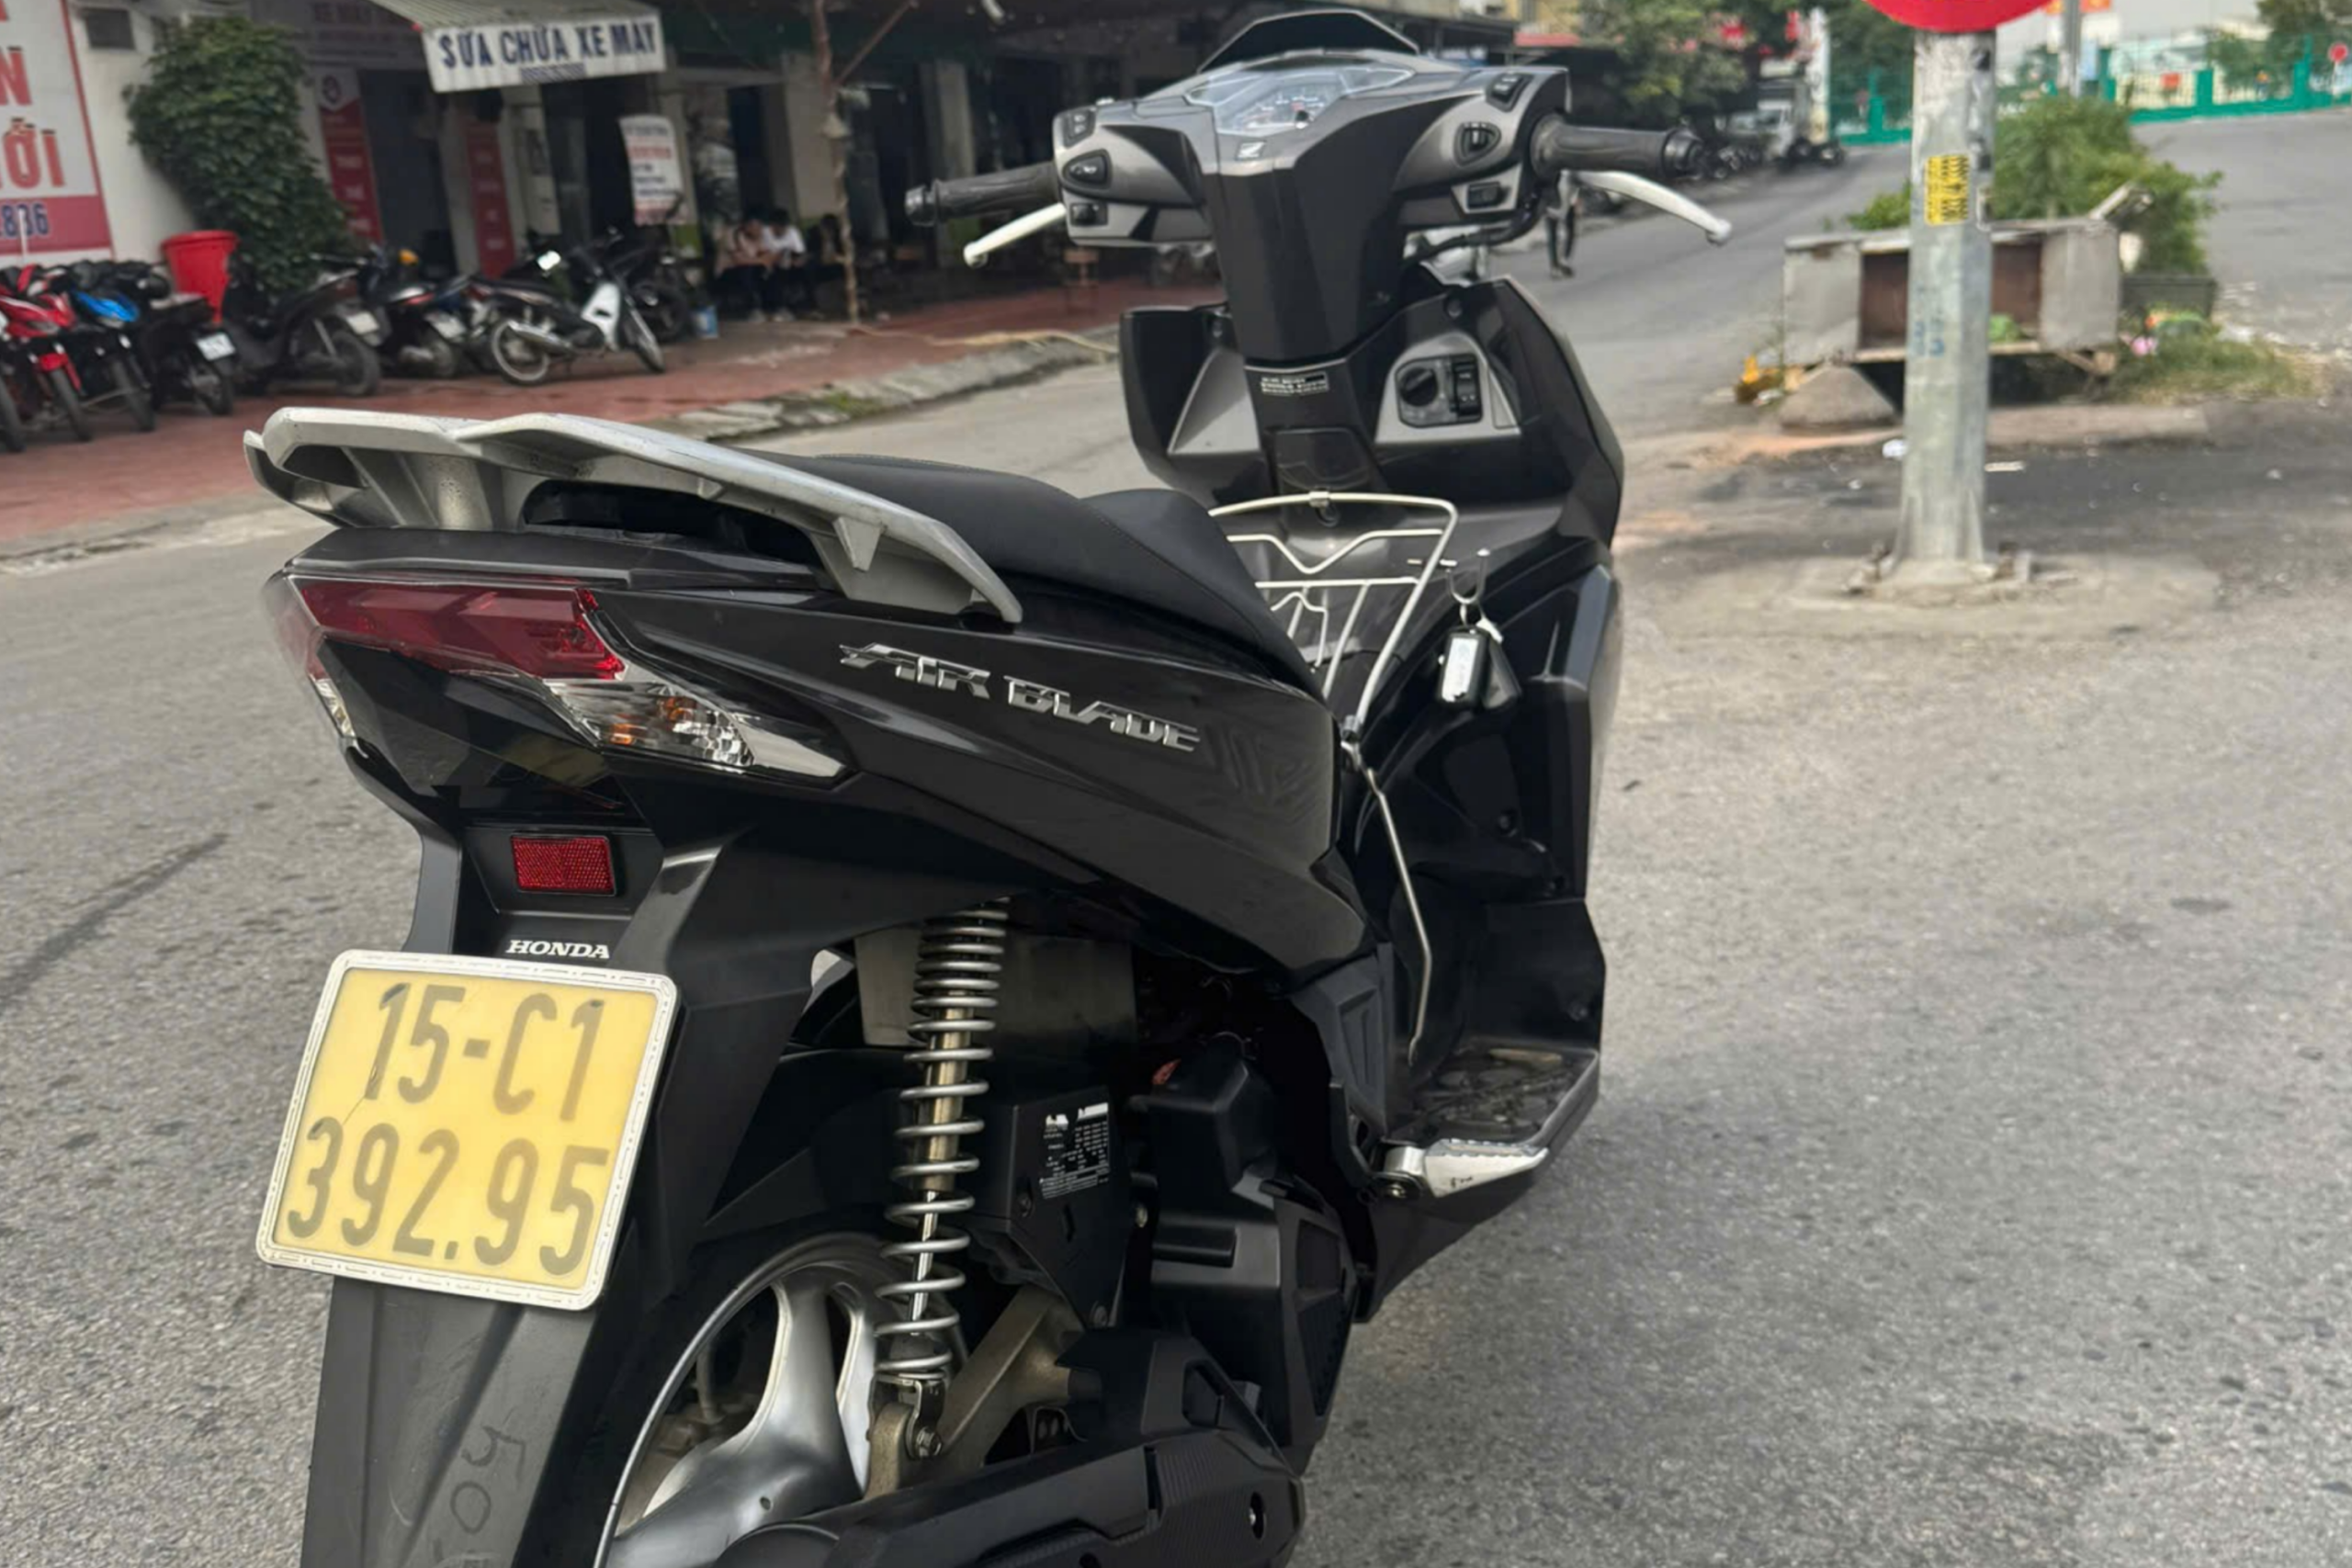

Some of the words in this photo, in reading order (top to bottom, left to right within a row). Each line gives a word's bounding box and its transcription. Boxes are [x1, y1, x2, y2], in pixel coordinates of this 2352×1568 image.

[575, 25, 606, 58] XE
[839, 642, 990, 700] AIR
[1003, 675, 1201, 752] BLADE
[504, 939, 610, 959] HONDA
[364, 981, 605, 1122] 15-C1
[287, 1115, 610, 1276] 392.95
